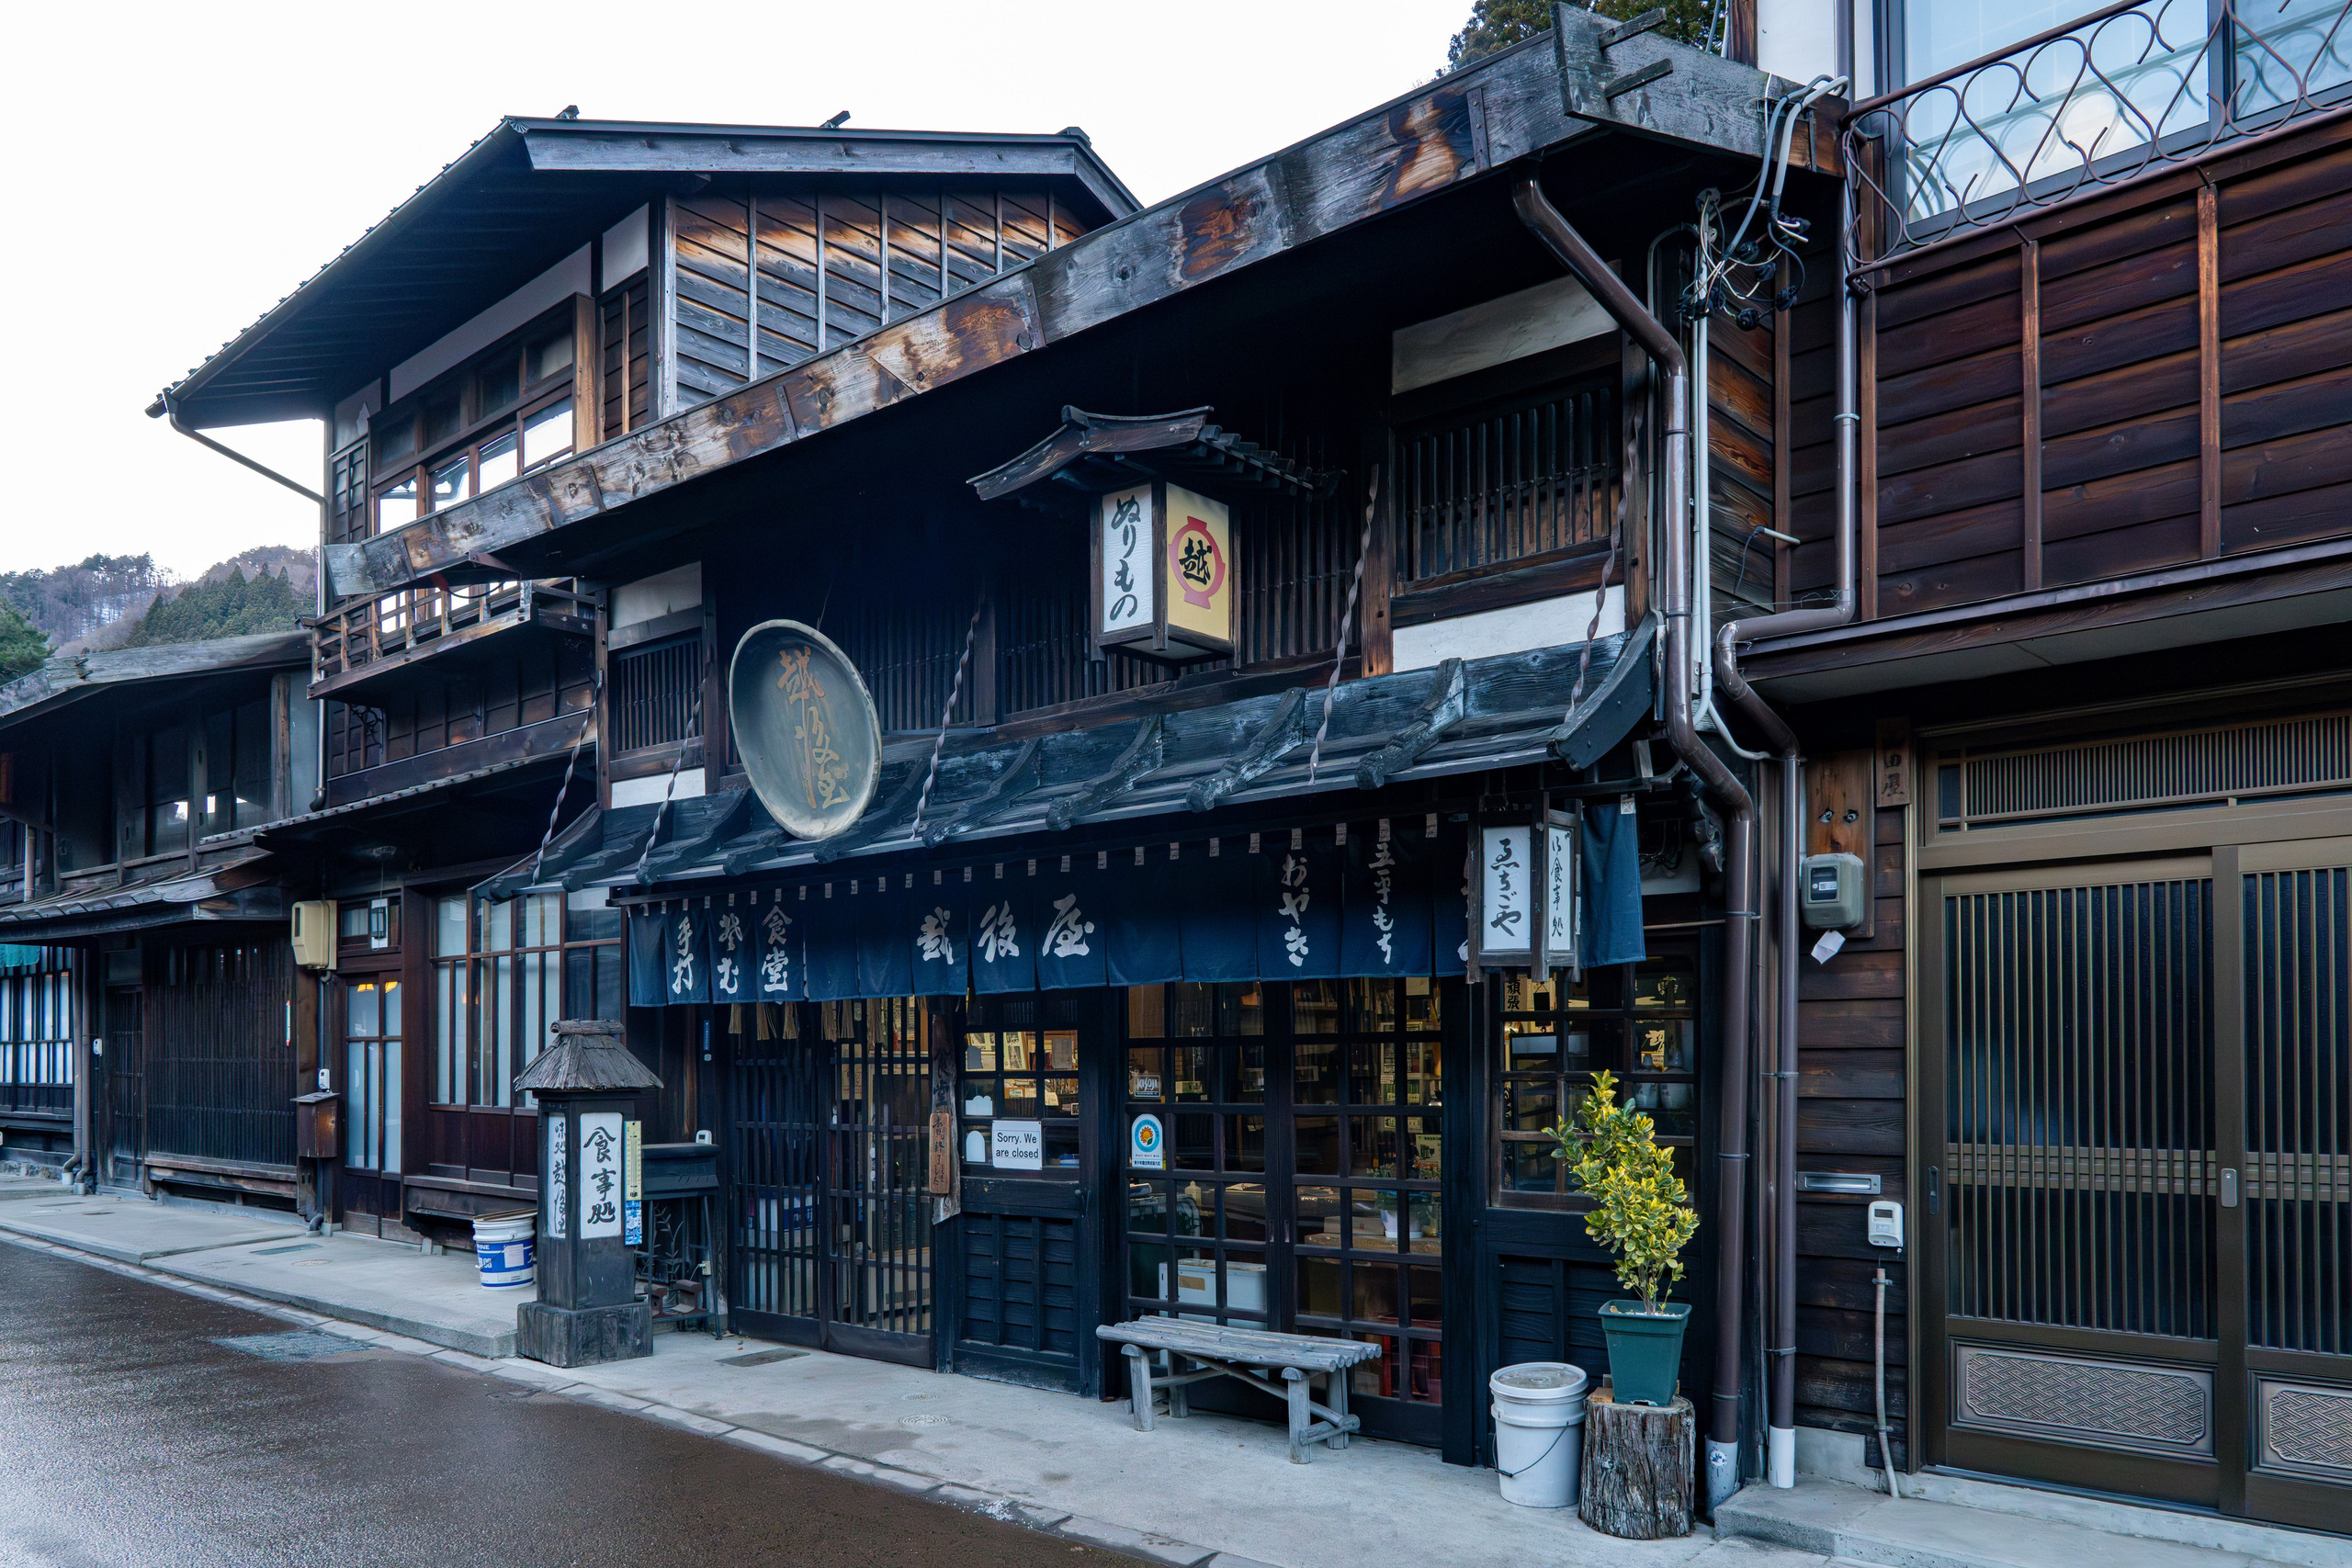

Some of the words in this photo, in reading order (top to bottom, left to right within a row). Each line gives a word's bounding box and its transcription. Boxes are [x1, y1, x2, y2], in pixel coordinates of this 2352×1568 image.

[1110, 494, 1141, 621] ぬりもの
[1179, 537, 1212, 585] 越
[1278, 853, 1310, 966] おやき
[1368, 842, 1396, 964] 五平もち
[672, 916, 694, 994] 手打
[761, 905, 793, 992] 食堂
[583, 1126, 616, 1224] 食事処
[1012, 1147, 1038, 1157] closed
[1023, 1133, 1036, 1144] We
